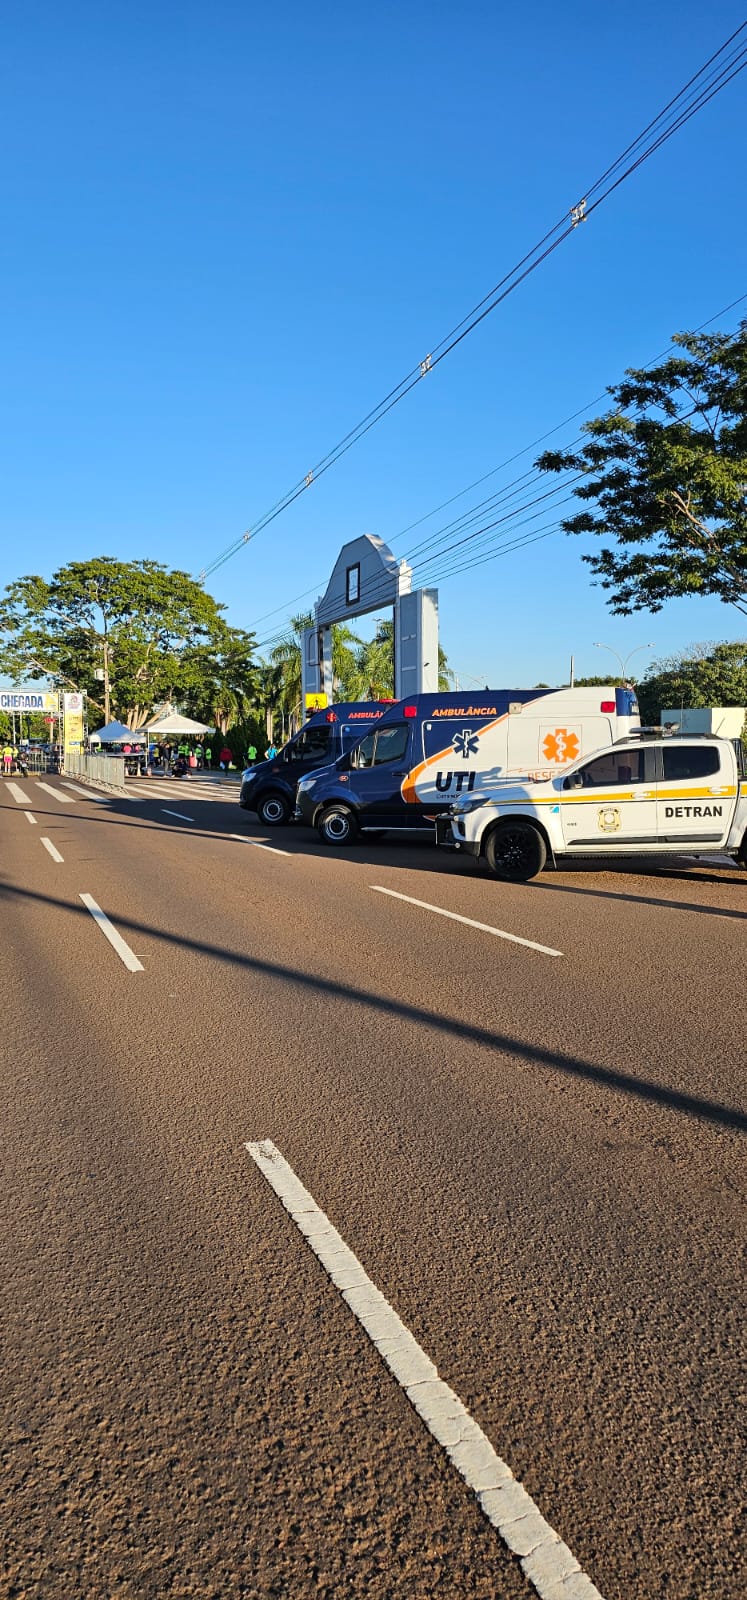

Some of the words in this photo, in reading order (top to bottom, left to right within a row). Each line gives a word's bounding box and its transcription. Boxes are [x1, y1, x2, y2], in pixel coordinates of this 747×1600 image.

[1, 695, 43, 708] CHEGADA
[431, 706, 498, 717] AMBULÂNCIA
[436, 771, 476, 792] UTI
[665, 806, 722, 818] DETRAN
